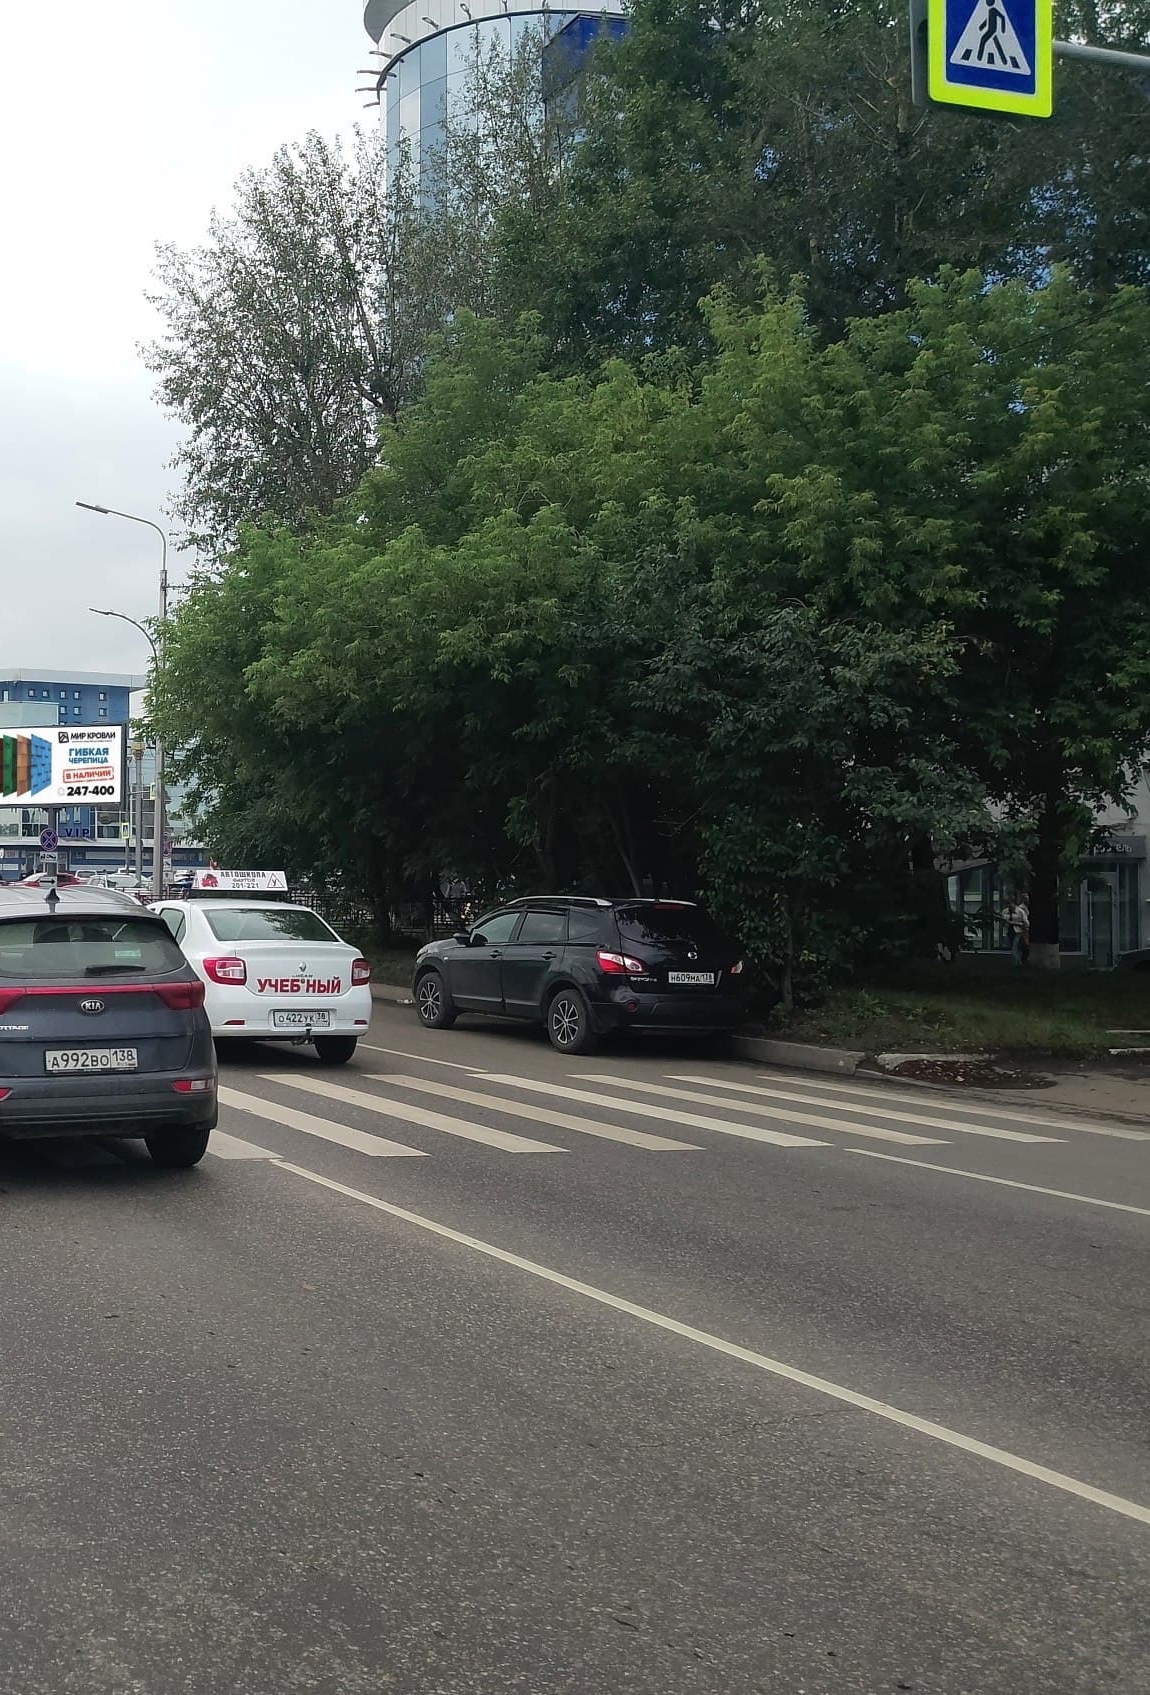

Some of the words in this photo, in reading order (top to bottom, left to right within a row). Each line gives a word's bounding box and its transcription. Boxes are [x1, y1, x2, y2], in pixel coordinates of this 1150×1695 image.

[70, 732, 86, 740] МИР
[87, 731, 116, 740] КРОВЛИ
[69, 747, 109, 757] ГИБКАЯ
[68, 756, 109, 765] ЧЕРЕПИЦА
[72, 770, 111, 779] НАЛИЧИИ
[66, 785, 115, 796] 247-400
[65, 828, 90, 838] VIP
[257, 976, 342, 994] УЧЕБНЫЙ
[84, 1001, 101, 1010] KIA
